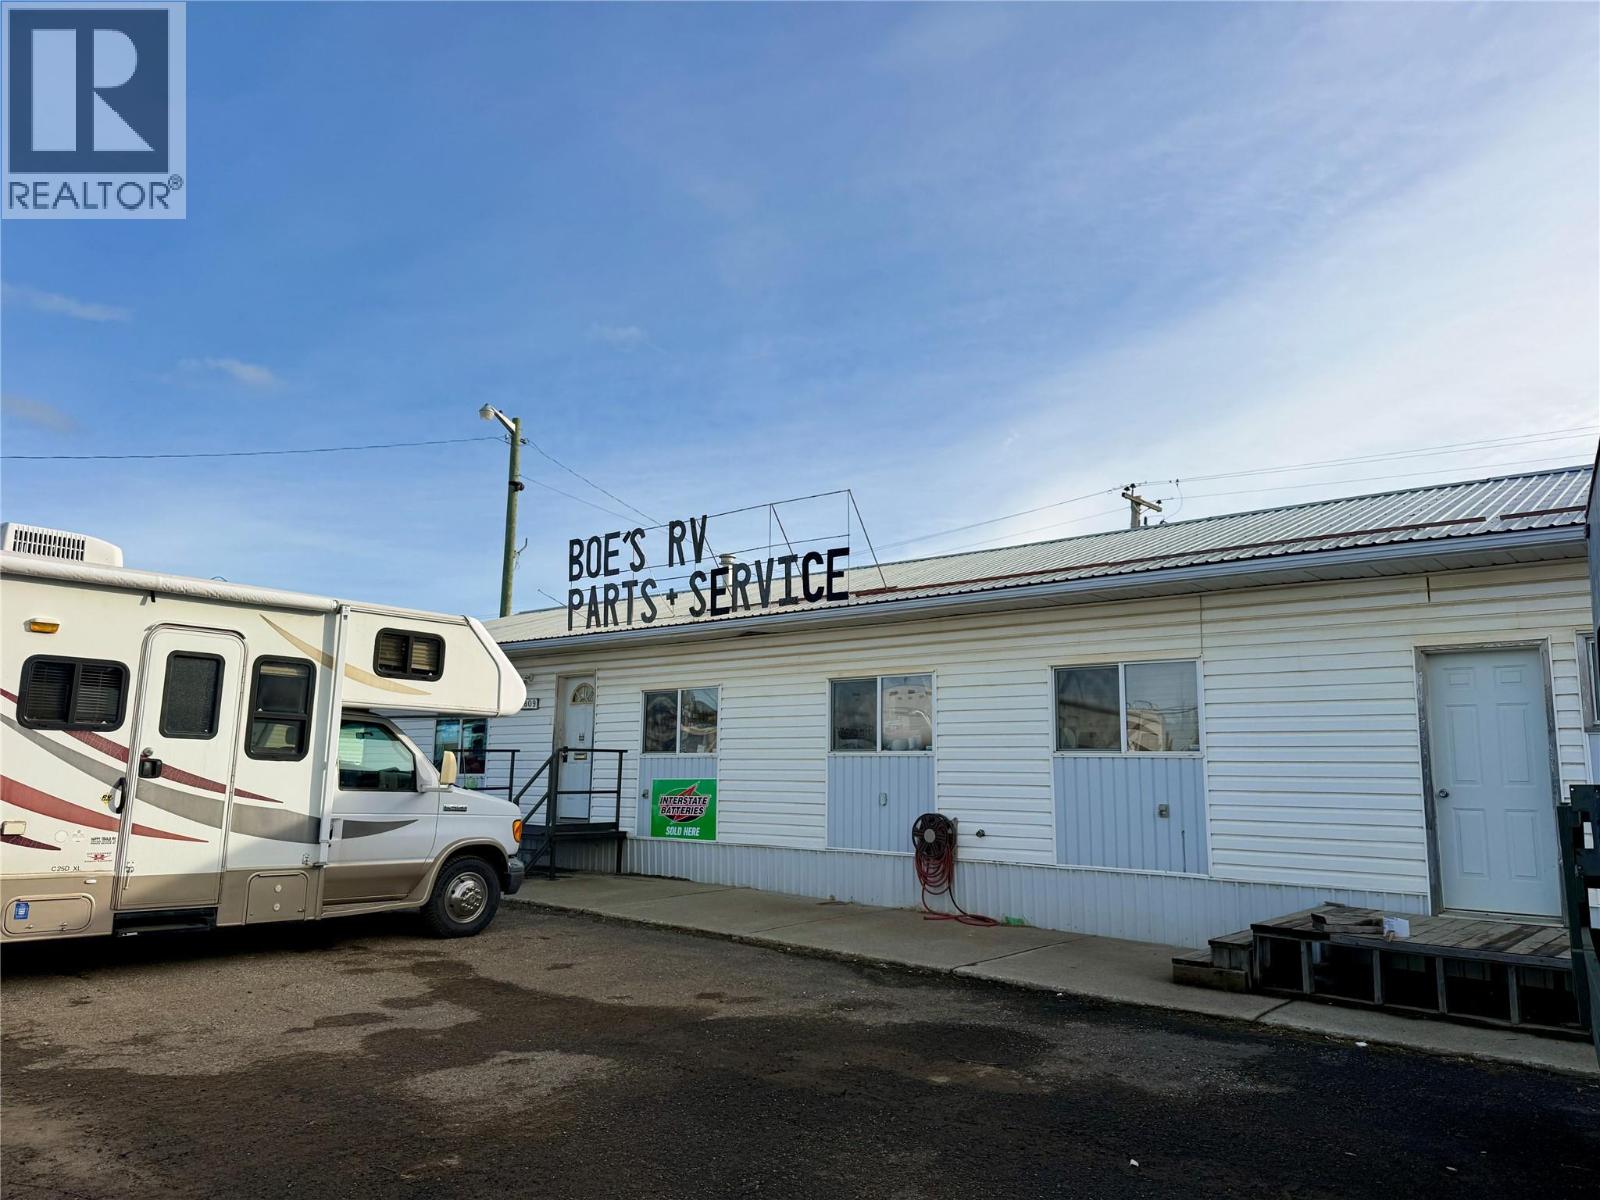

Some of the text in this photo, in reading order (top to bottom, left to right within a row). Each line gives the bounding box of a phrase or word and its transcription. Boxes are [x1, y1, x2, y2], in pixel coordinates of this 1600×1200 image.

[568, 514, 708, 582] BOE'S RV
[567, 578, 658, 631] PARTS
[688, 546, 850, 618] SERVICE
[660, 796, 707, 805] INTERSTATE
[661, 806, 704, 815] BATTERIES
[665, 826, 700, 836] SOLD HERE
